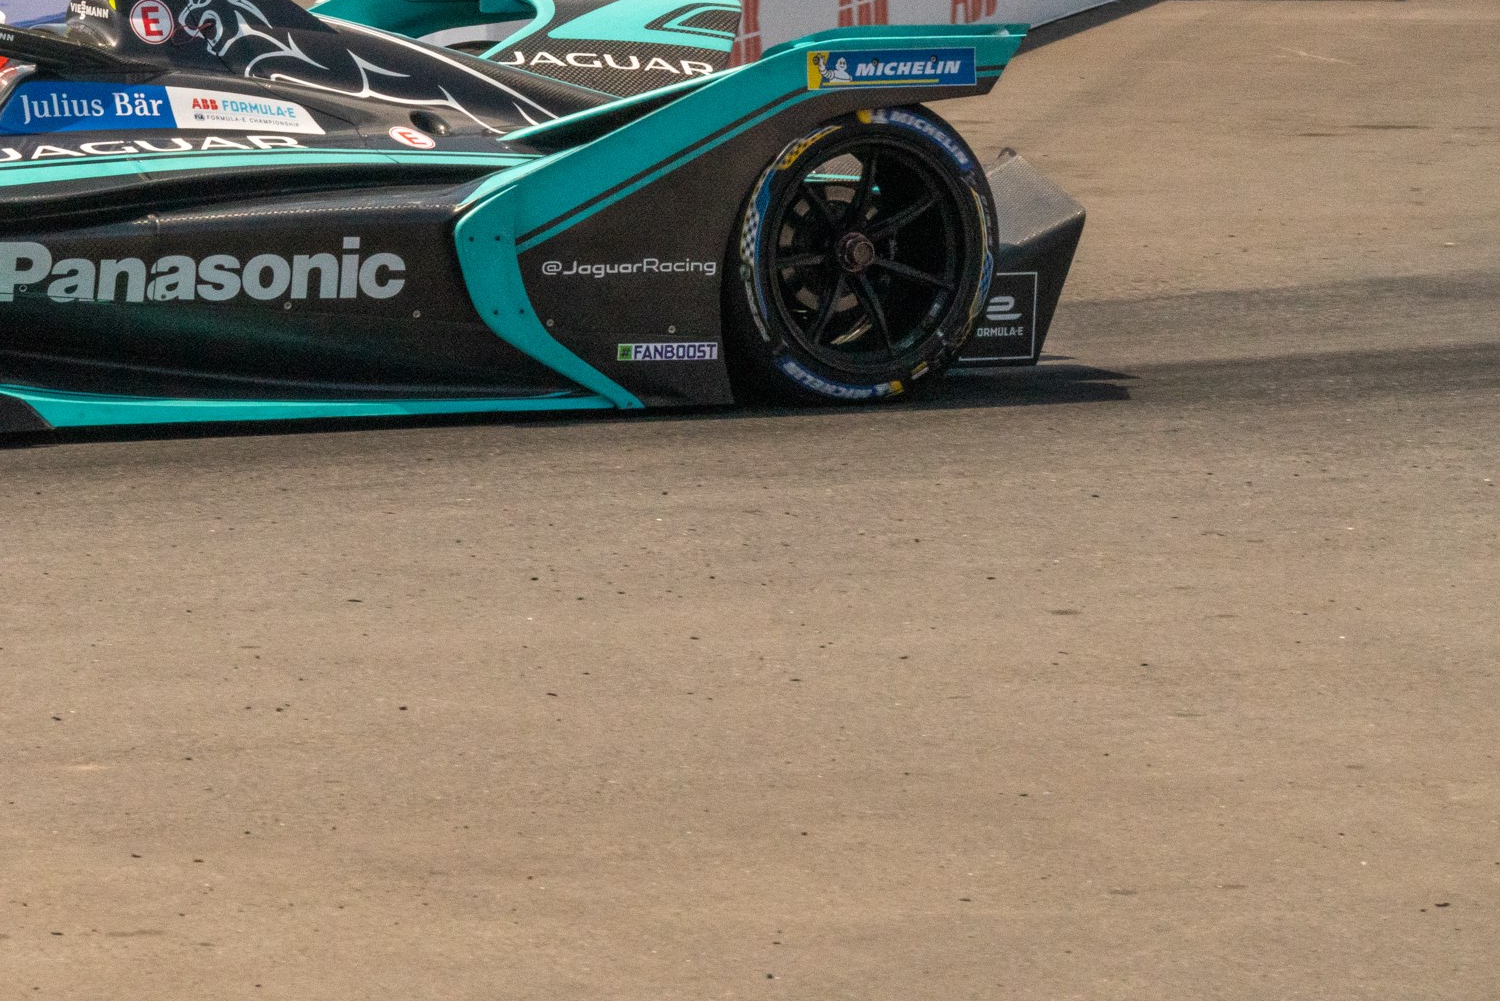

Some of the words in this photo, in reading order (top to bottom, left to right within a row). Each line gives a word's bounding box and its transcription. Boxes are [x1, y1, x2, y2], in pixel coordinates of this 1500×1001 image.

[70, 0, 109, 20] VIESSMANN
[141, 6, 163, 37] E
[498, 51, 714, 76] JAGUAR
[855, 61, 961, 77] MICHELIN
[20, 92, 104, 124] Julius
[112, 91, 163, 118] Bär
[192, 98, 219, 111] ABB
[542, 258, 717, 279] @JaguarRacing
[976, 326, 1024, 337] ORMULA-E
